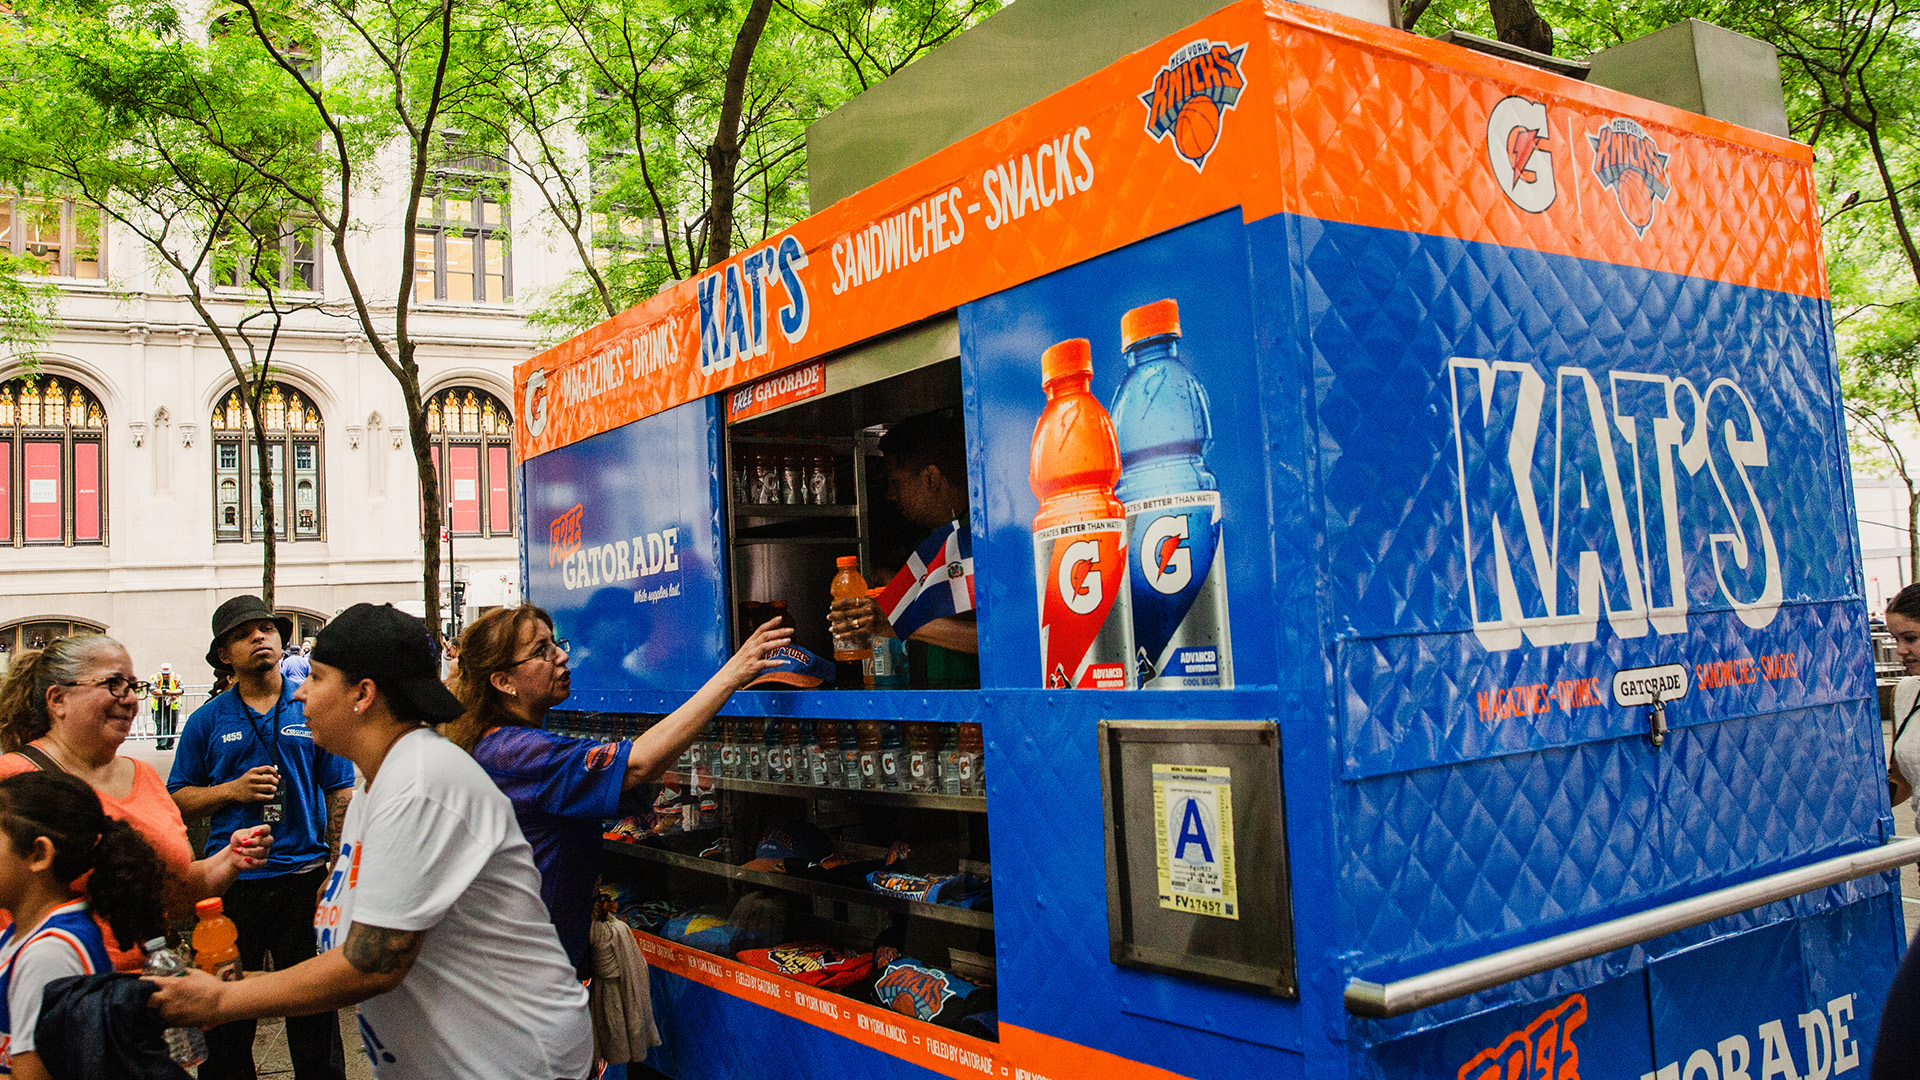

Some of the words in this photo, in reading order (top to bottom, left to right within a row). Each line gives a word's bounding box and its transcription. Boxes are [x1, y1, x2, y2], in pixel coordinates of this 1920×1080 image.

[1170, 50, 1187, 69] NEW
[1187, 42, 1209, 57] YORK
[1148, 45, 1243, 130] KNICKS
[1594, 126, 1670, 189] KNICKS
[697, 233, 811, 377] KAT'S
[731, 384, 756, 416] FREE
[755, 364, 819, 403] GATORADE
[1143, 497, 1172, 509] BETTER
[1175, 493, 1195, 504] THAN
[1448, 357, 1784, 653] KAT'S
[550, 503, 583, 568] FREE
[1060, 523, 1085, 535] BETTER
[1088, 520, 1105, 530] THAN
[563, 527, 679, 590] GATORADE
[221, 731, 243, 743] 1455
[1174, 798, 1215, 864] A
[794, 991, 805, 1007] NEW
[805, 995, 819, 1012] YORK
[819, 999, 838, 1019] KNICKS
[857, 1013, 869, 1030] NEW
[869, 1017, 885, 1036] YORK
[885, 1023, 907, 1044] KNICKS
[926, 1037, 949, 1060] FUELED
[949, 1044, 958, 1063] BY
